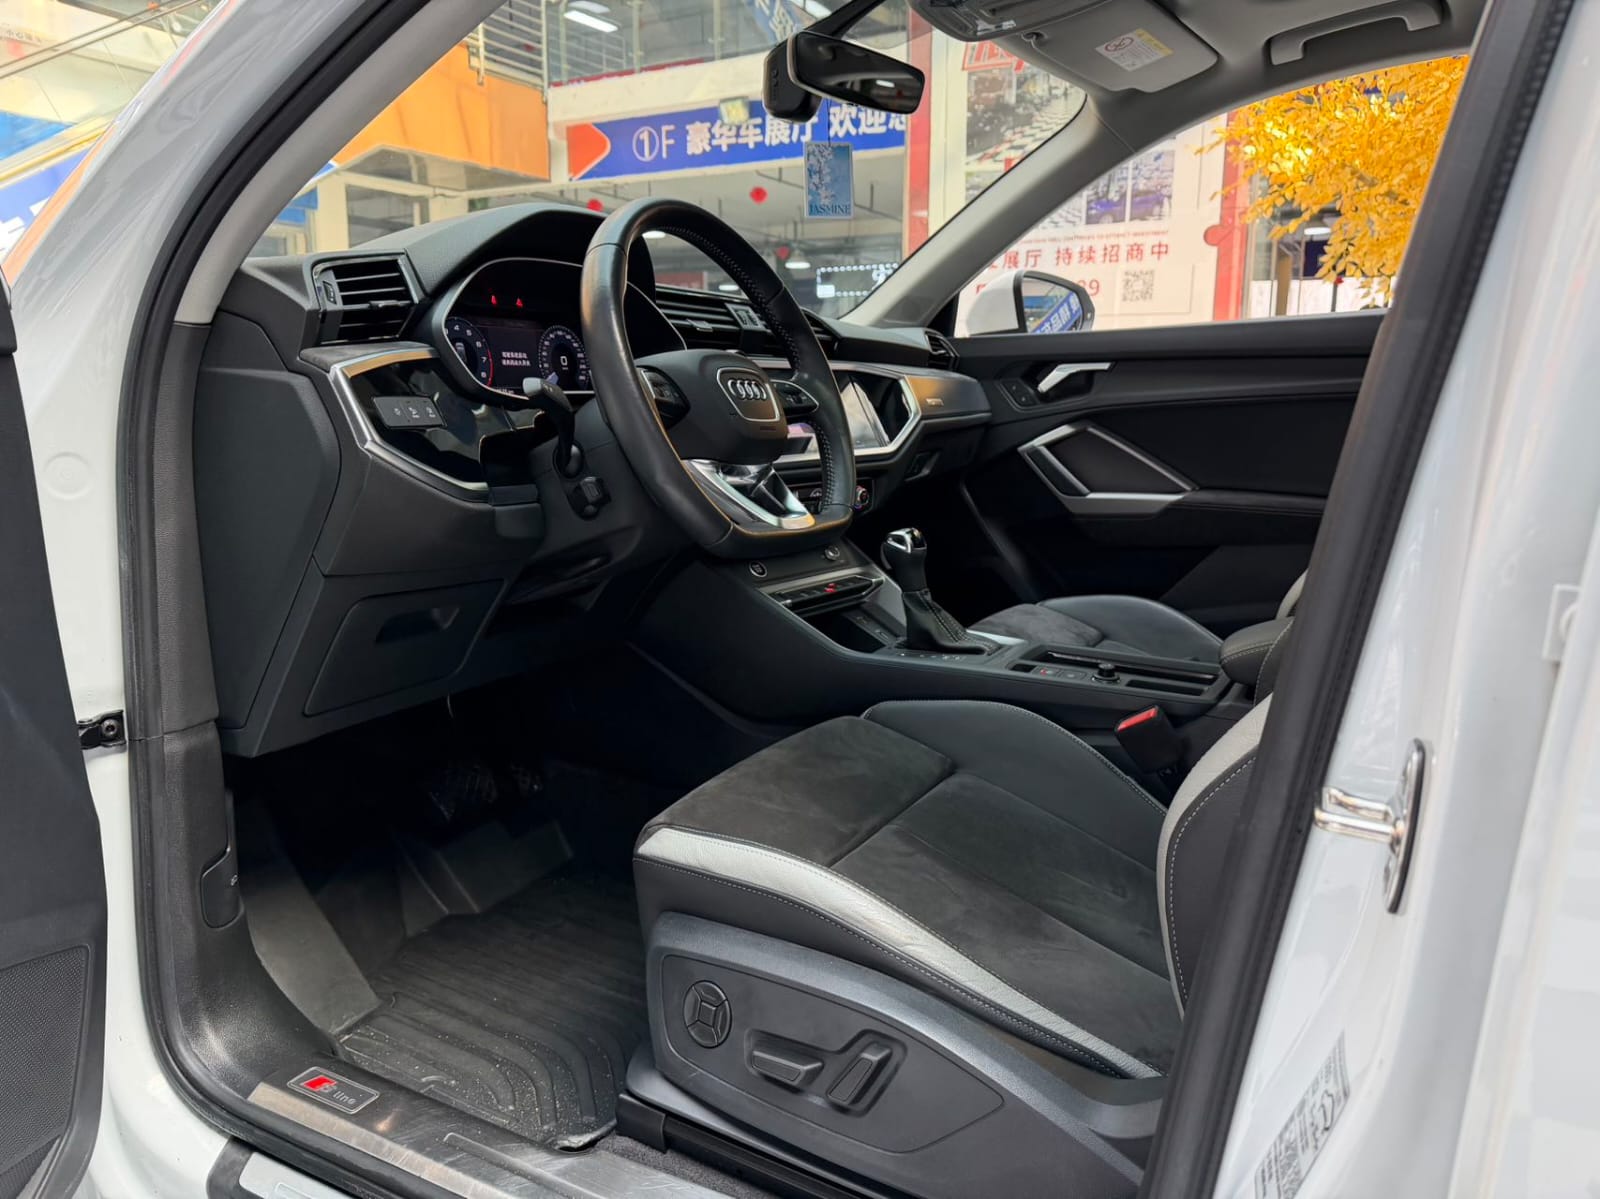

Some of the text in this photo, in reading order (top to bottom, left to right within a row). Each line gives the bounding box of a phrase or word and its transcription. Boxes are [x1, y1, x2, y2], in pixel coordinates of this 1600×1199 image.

[685, 114, 818, 156] 豪华车展厅
[809, 204, 851, 215] JASMINE
[988, 241, 1169, 270] 展厅 持续招商中
[332, 1091, 357, 1105] line
